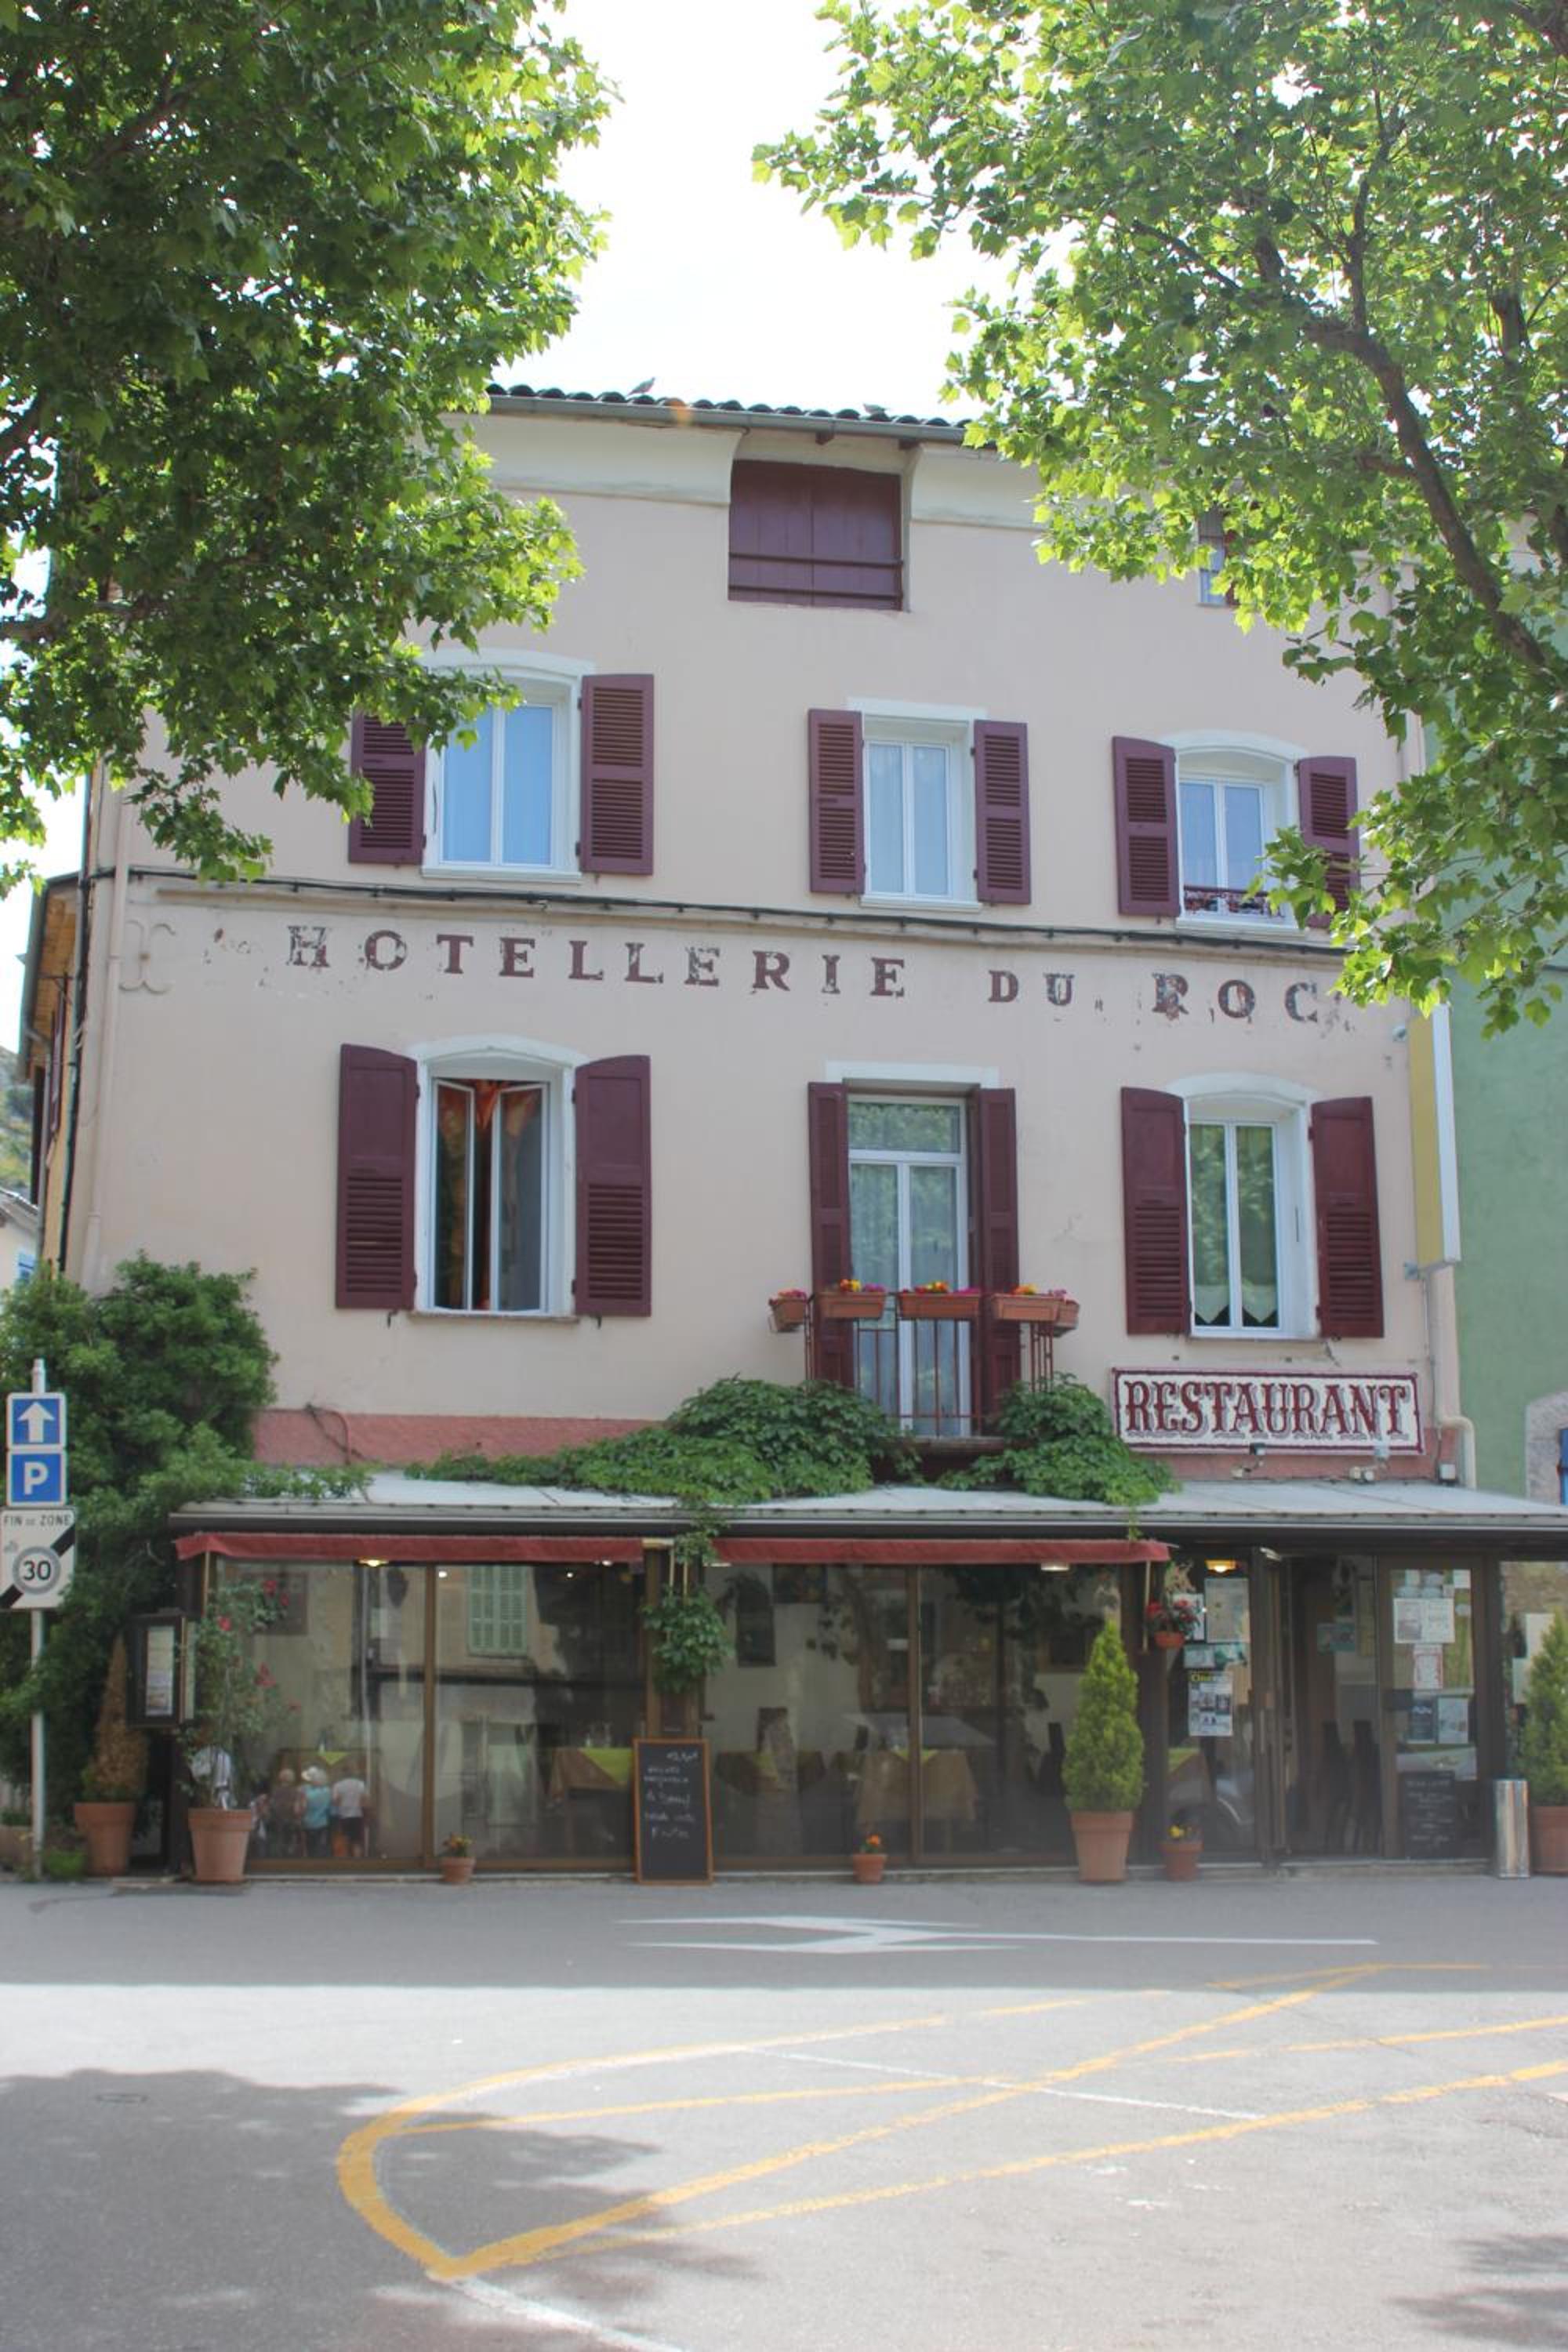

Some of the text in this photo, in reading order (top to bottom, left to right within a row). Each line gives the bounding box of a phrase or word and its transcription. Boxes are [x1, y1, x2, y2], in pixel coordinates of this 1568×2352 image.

[287, 924, 906, 997] HOTELLERIE
[988, 970, 1074, 1007] DU
[1123, 1380, 1409, 1437] RESTAURANT
[24, 1461, 49, 1494] P
[4, 1515, 22, 1526] FIN
[40, 1514, 71, 1526] ZONE
[23, 1560, 51, 1581] 30
